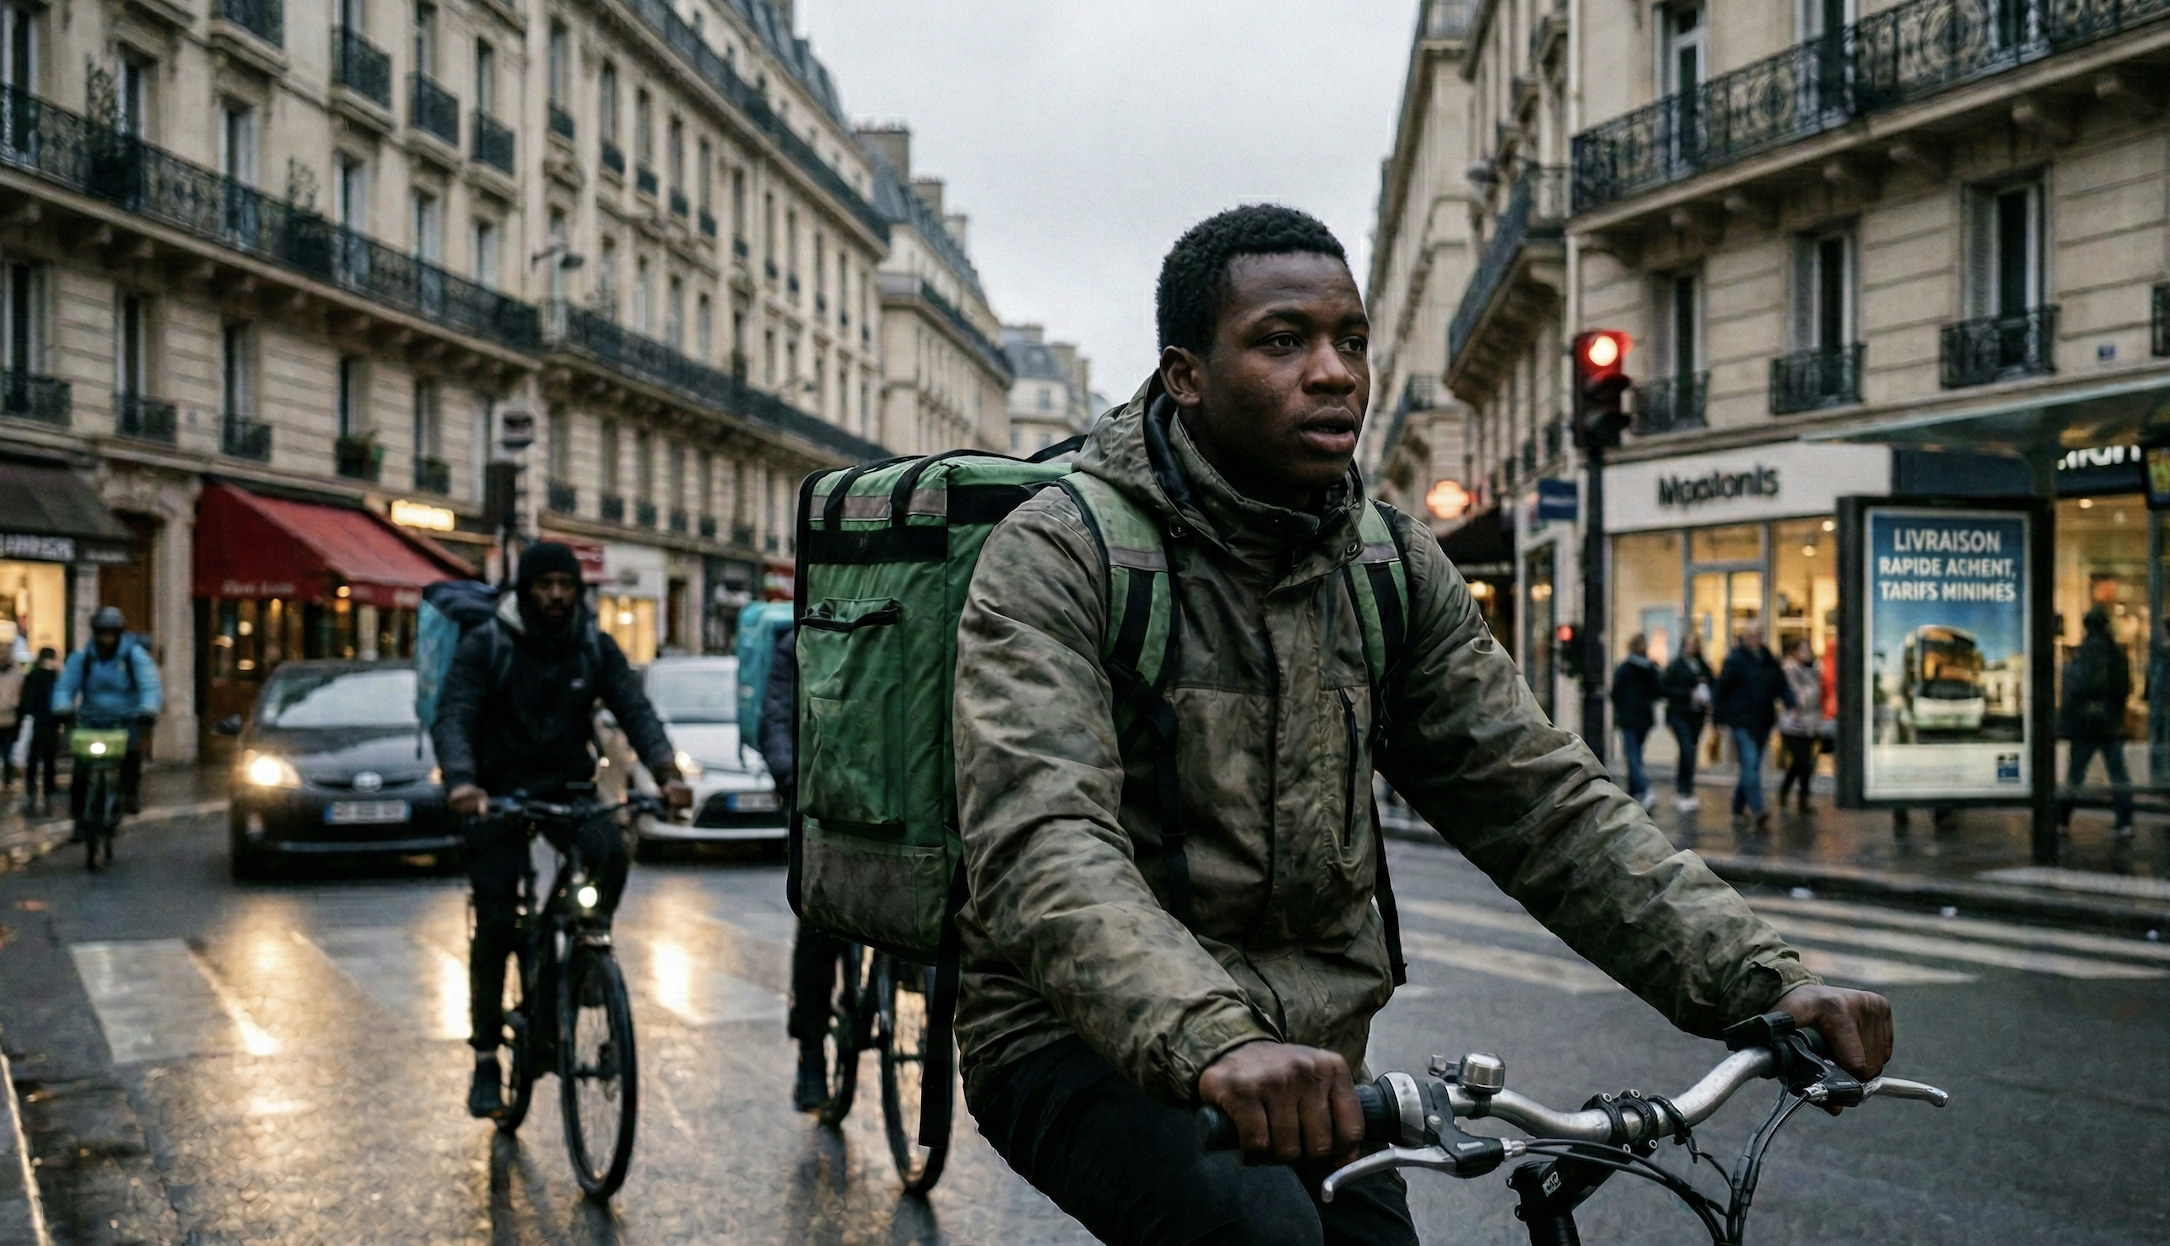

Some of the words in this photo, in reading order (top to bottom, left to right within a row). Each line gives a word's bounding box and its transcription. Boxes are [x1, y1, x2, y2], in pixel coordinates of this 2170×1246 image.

[1894, 528, 2001, 553] LIVRAISON
[1879, 556, 1942, 577] RAPIDE
[1880, 580, 1939, 601] TARIFS
